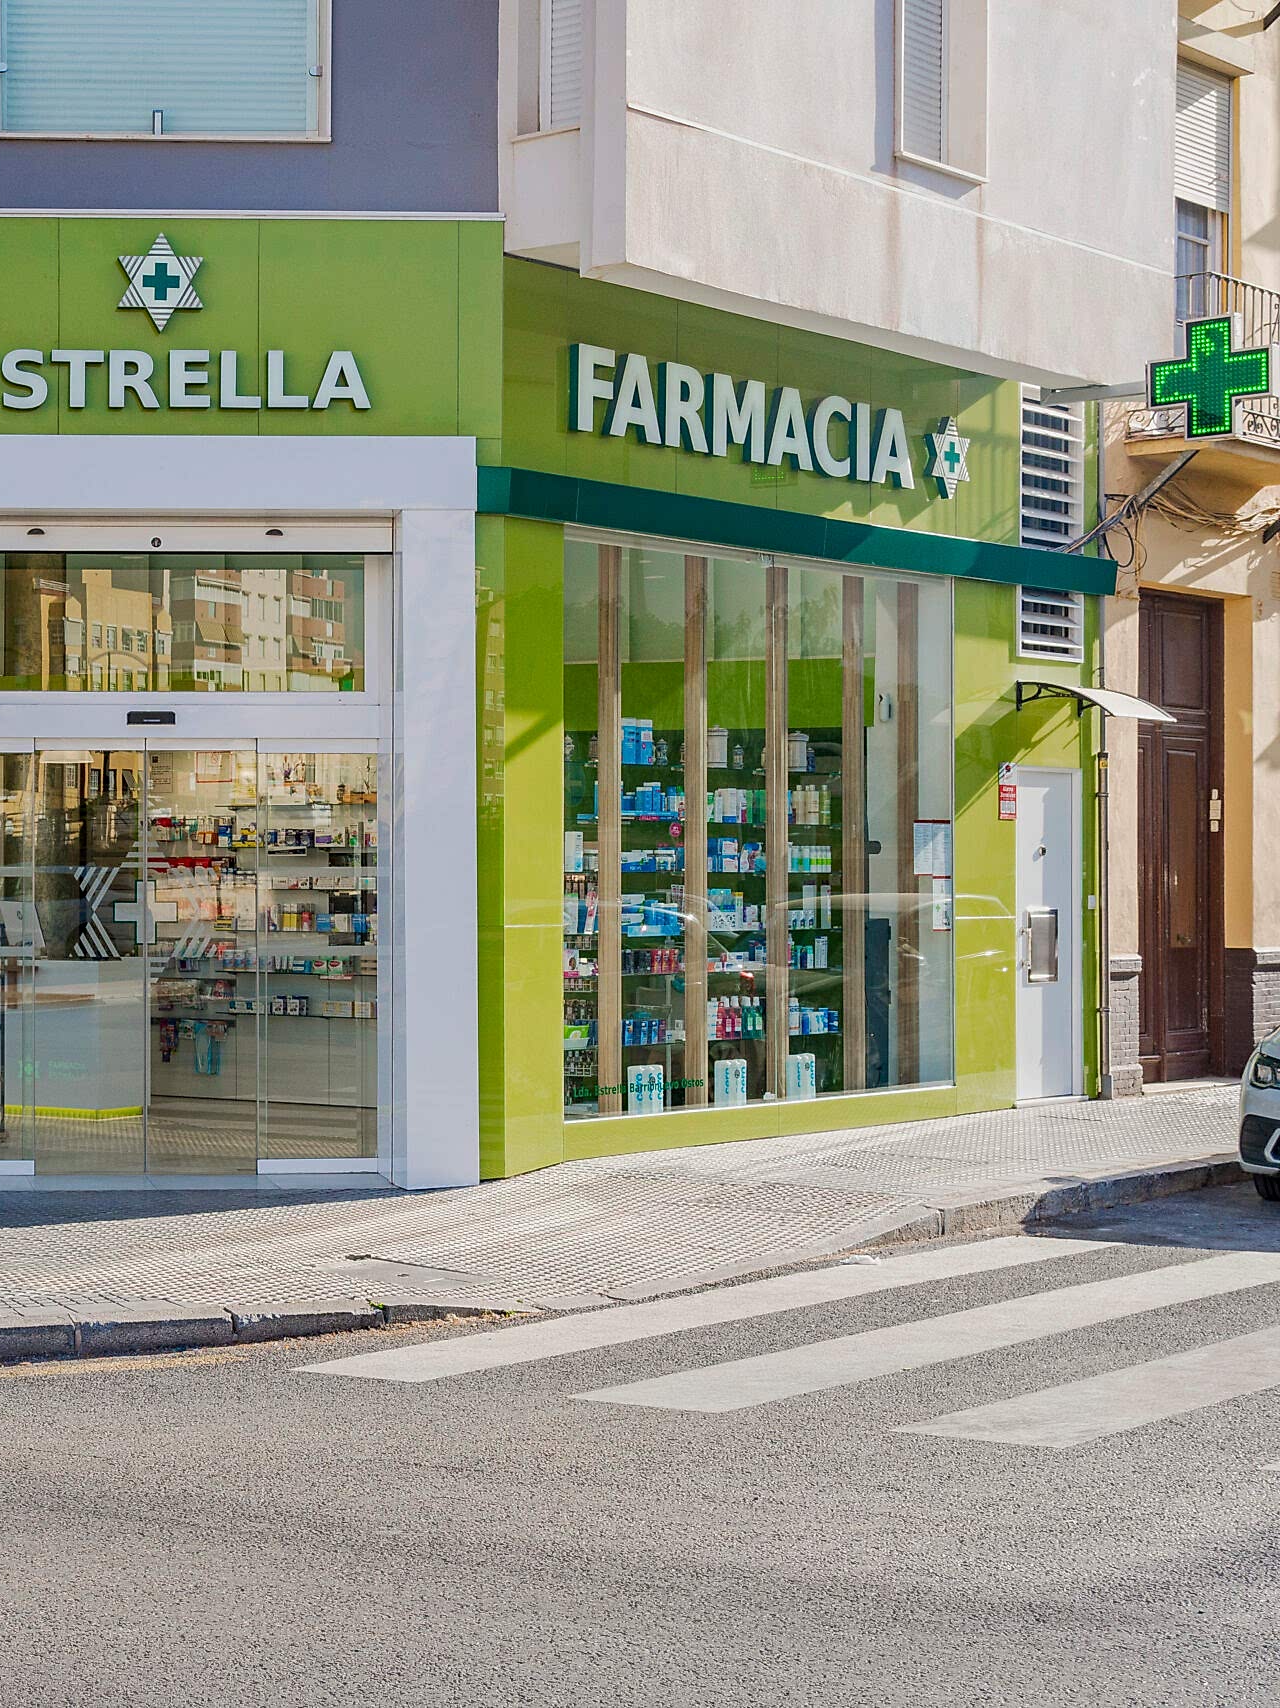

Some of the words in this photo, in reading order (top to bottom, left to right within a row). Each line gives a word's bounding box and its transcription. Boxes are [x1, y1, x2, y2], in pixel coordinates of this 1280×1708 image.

[573, 342, 915, 490] FARMACIA
[595, 1084, 627, 1096] Estrella
[630, 1080, 679, 1093] Barrionuevo
[682, 1077, 704, 1088] Ostos
